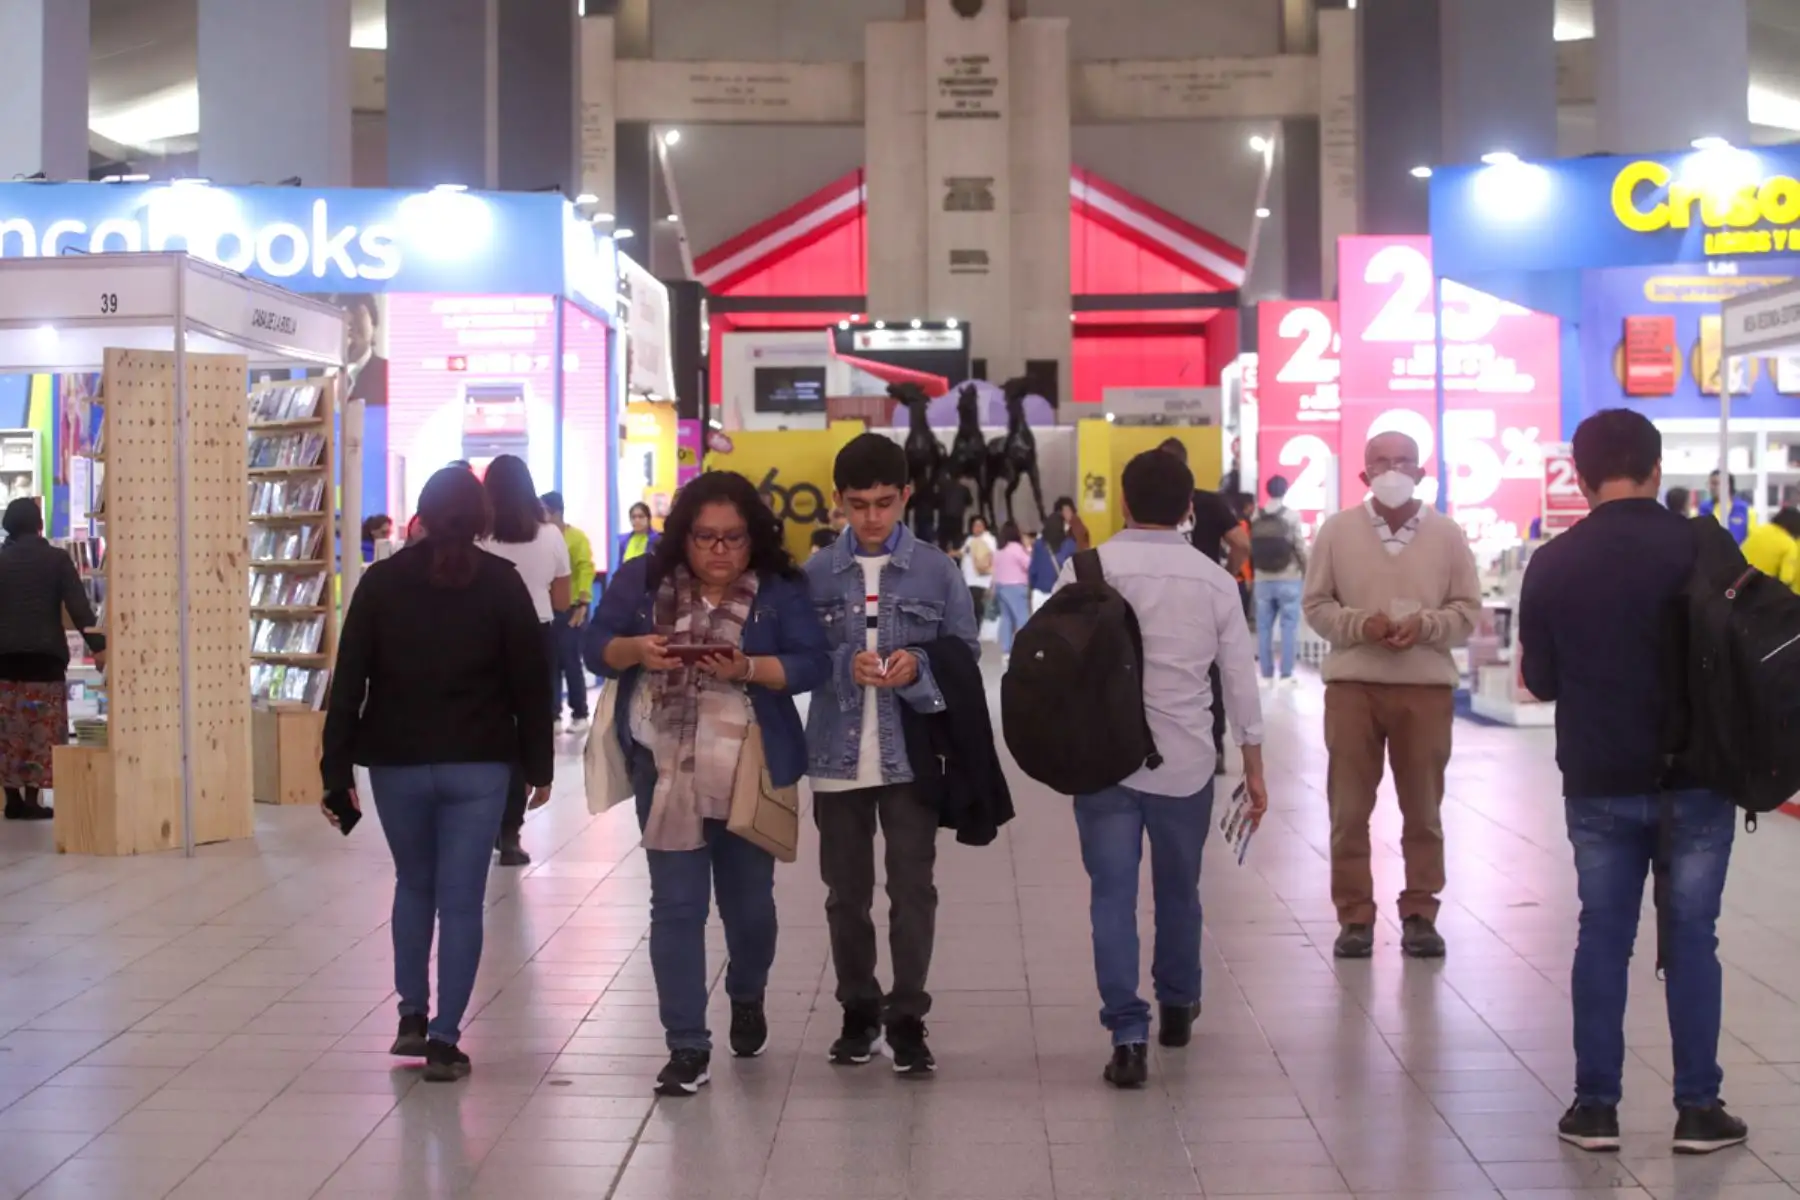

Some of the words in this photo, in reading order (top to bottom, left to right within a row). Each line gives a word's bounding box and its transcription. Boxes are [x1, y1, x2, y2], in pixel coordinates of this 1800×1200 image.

[100, 293, 118, 313] 39
[1276, 306, 1341, 383] 2
[1547, 459, 1582, 495] 2
